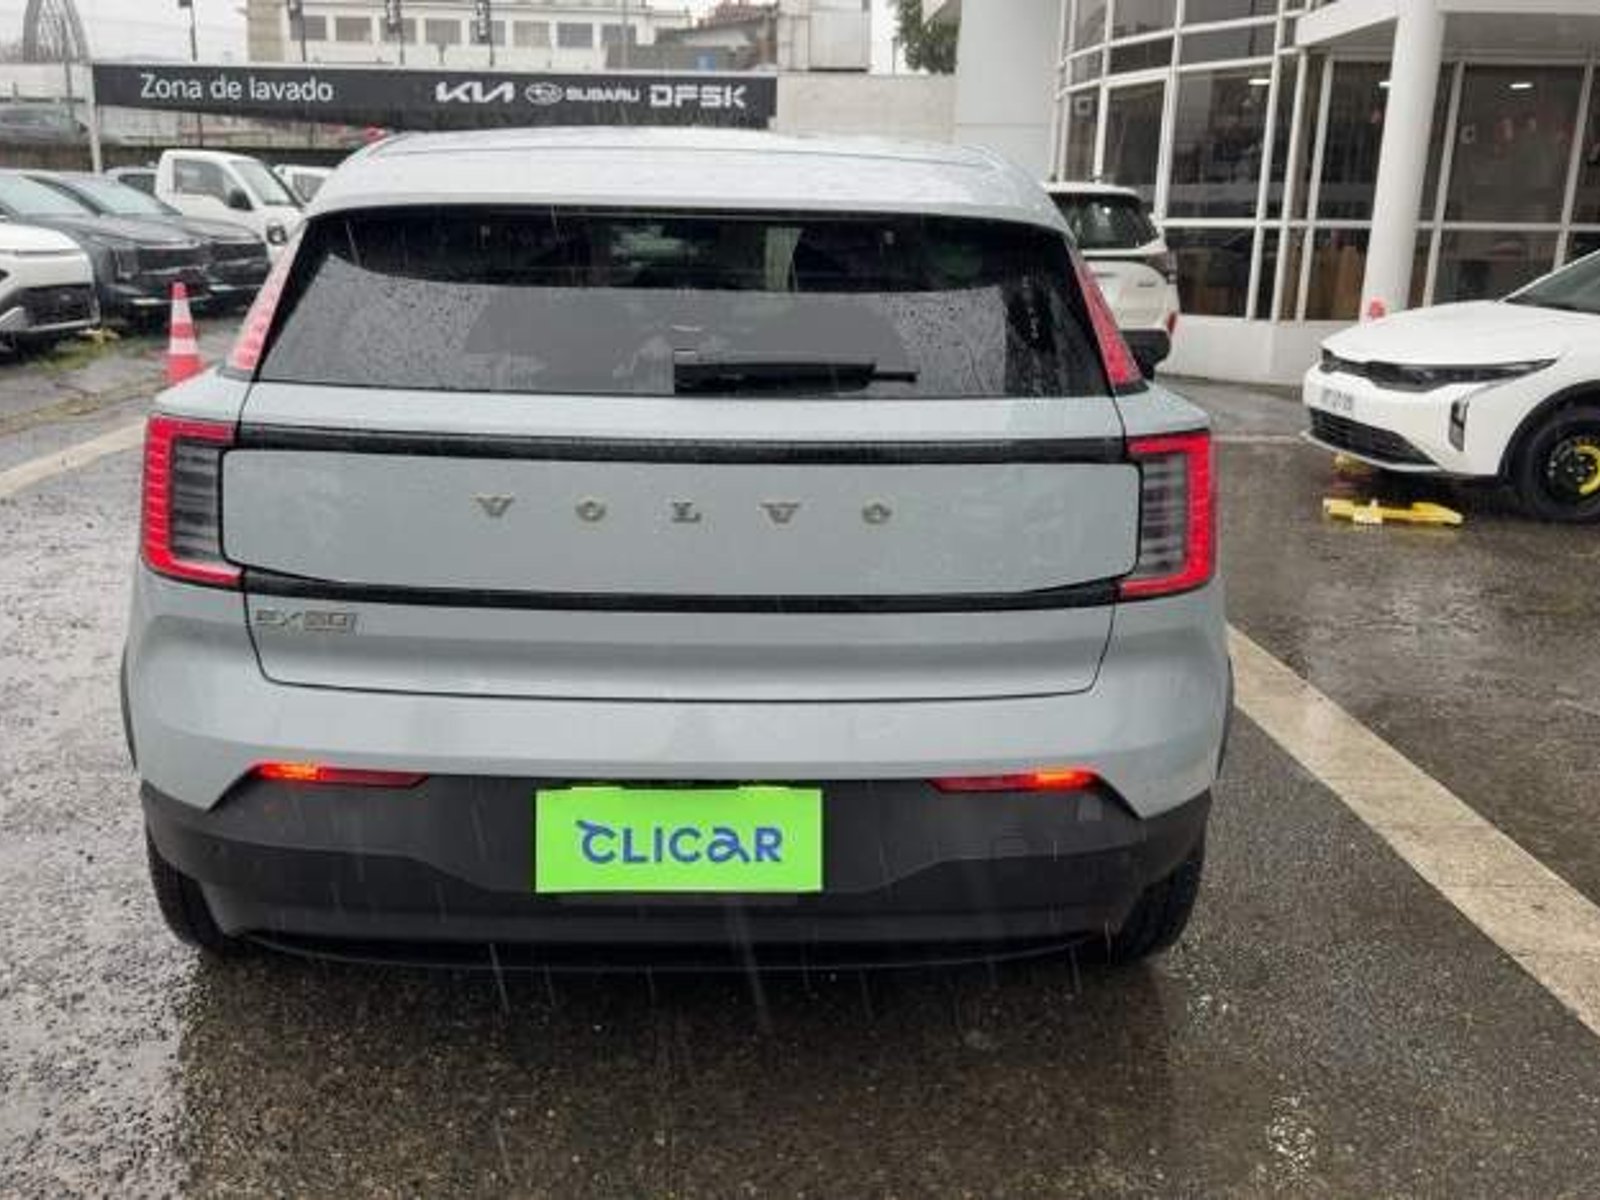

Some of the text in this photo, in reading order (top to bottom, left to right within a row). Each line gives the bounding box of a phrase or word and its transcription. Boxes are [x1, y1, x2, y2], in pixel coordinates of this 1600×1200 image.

[140, 73, 334, 101] Zona de lavado
[566, 86, 640, 101] SUBARU
[650, 84, 747, 108] DFSK
[477, 496, 893, 525] VOLVO
